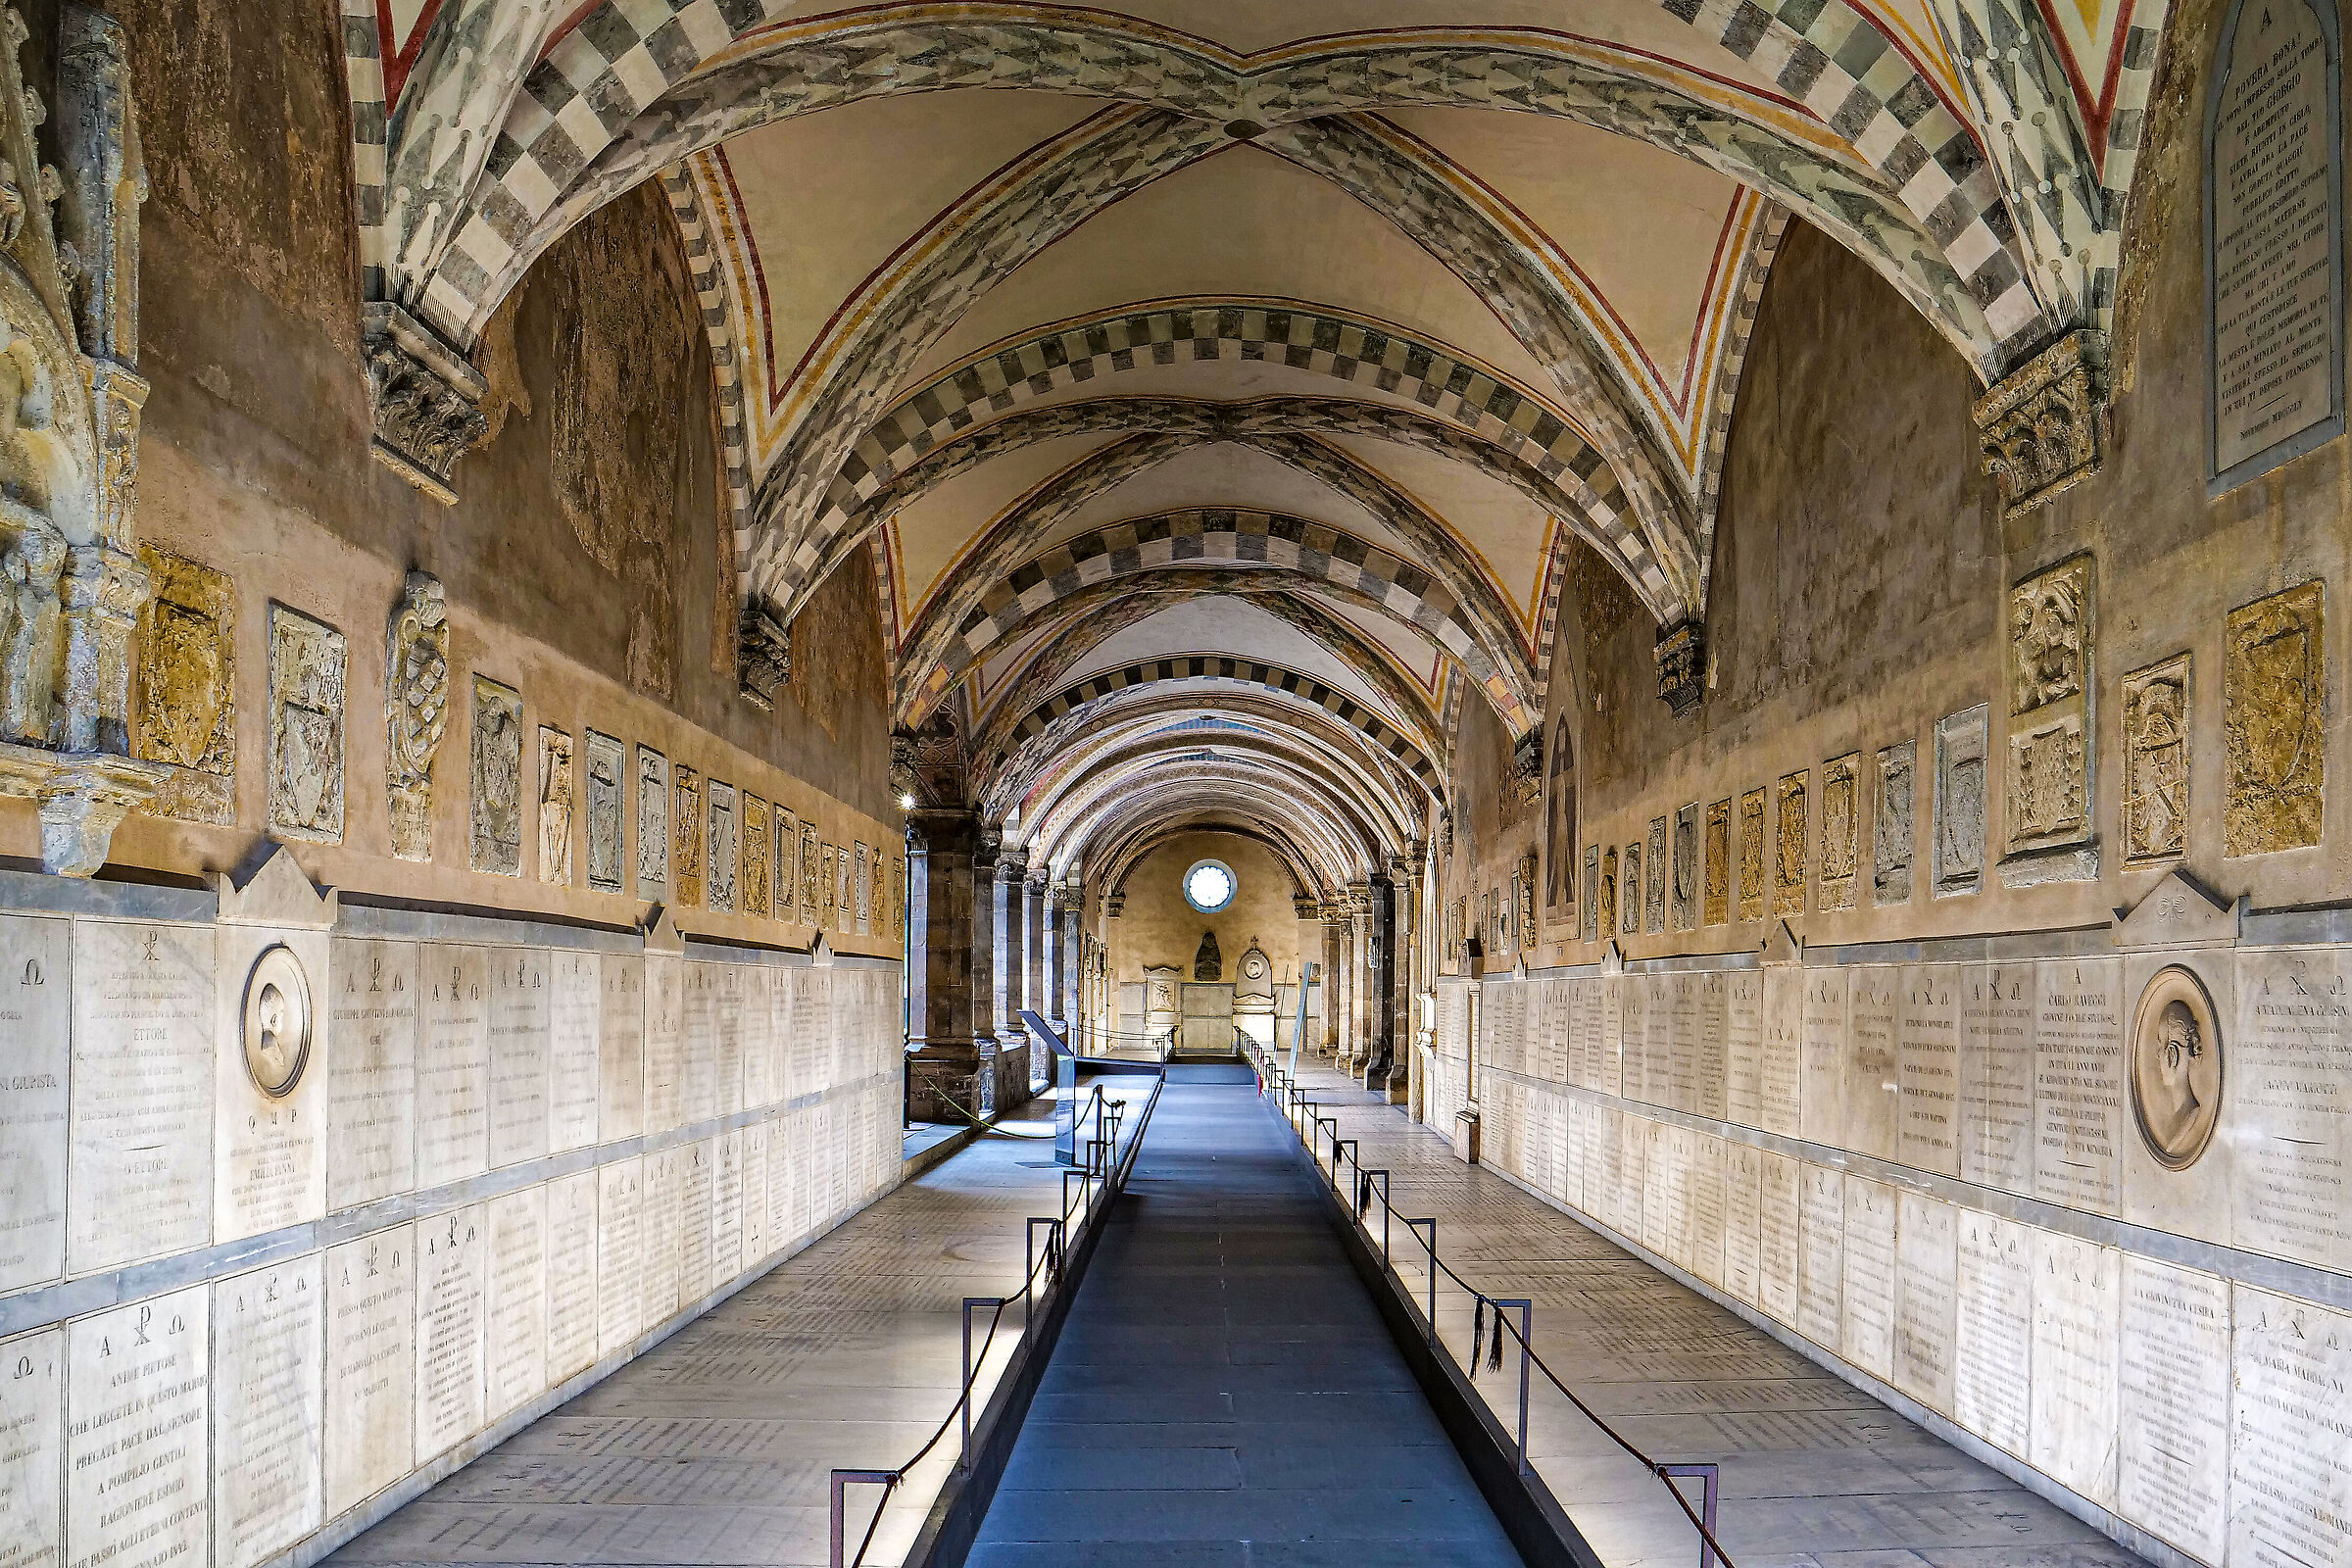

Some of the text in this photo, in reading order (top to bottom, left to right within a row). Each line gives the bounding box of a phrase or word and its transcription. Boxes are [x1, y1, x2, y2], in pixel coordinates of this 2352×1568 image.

[2226, 105, 2241, 122] VOTO
[2243, 76, 2274, 109] IMPRESSO
[2277, 57, 2298, 80] SULLA
[2300, 35, 2325, 59] TOMBA
[2234, 63, 2269, 100] POVERA
[2236, 73, 2301, 135] DEL TUO GIORGIO
[2261, 152, 2275, 167] ORA
[2278, 141, 2287, 154] LA
[2290, 122, 2310, 144] PACE
[2230, 154, 2248, 175] SIETE
[2275, 167, 2299, 191] EDITTO
[2274, 197, 2307, 226] MATERNE
[2074, 967, 2082, 985] A
[133, 1028, 168, 1041] ETTORE
[291, 1108, 297, 1123] P
[342, 1266, 351, 1288] A
[99, 1336, 112, 1358] A
[111, 1353, 177, 1388] ANIME PIETOSE
[70, 1421, 89, 1438] CHE
[92, 1400, 133, 1430] LEGGETE
[135, 1398, 145, 1412] IN
[179, 1374, 208, 1394] MARMO
[75, 1407, 202, 1471] PREGATE PACE DAL SIGNORE
[97, 1482, 105, 1495] A
[153, 1446, 187, 1471] GENTILI
[100, 1491, 154, 1529] RAGIONIERE
[119, 1533, 138, 1552] AGLI
[167, 1497, 207, 1527] CONTENTI
